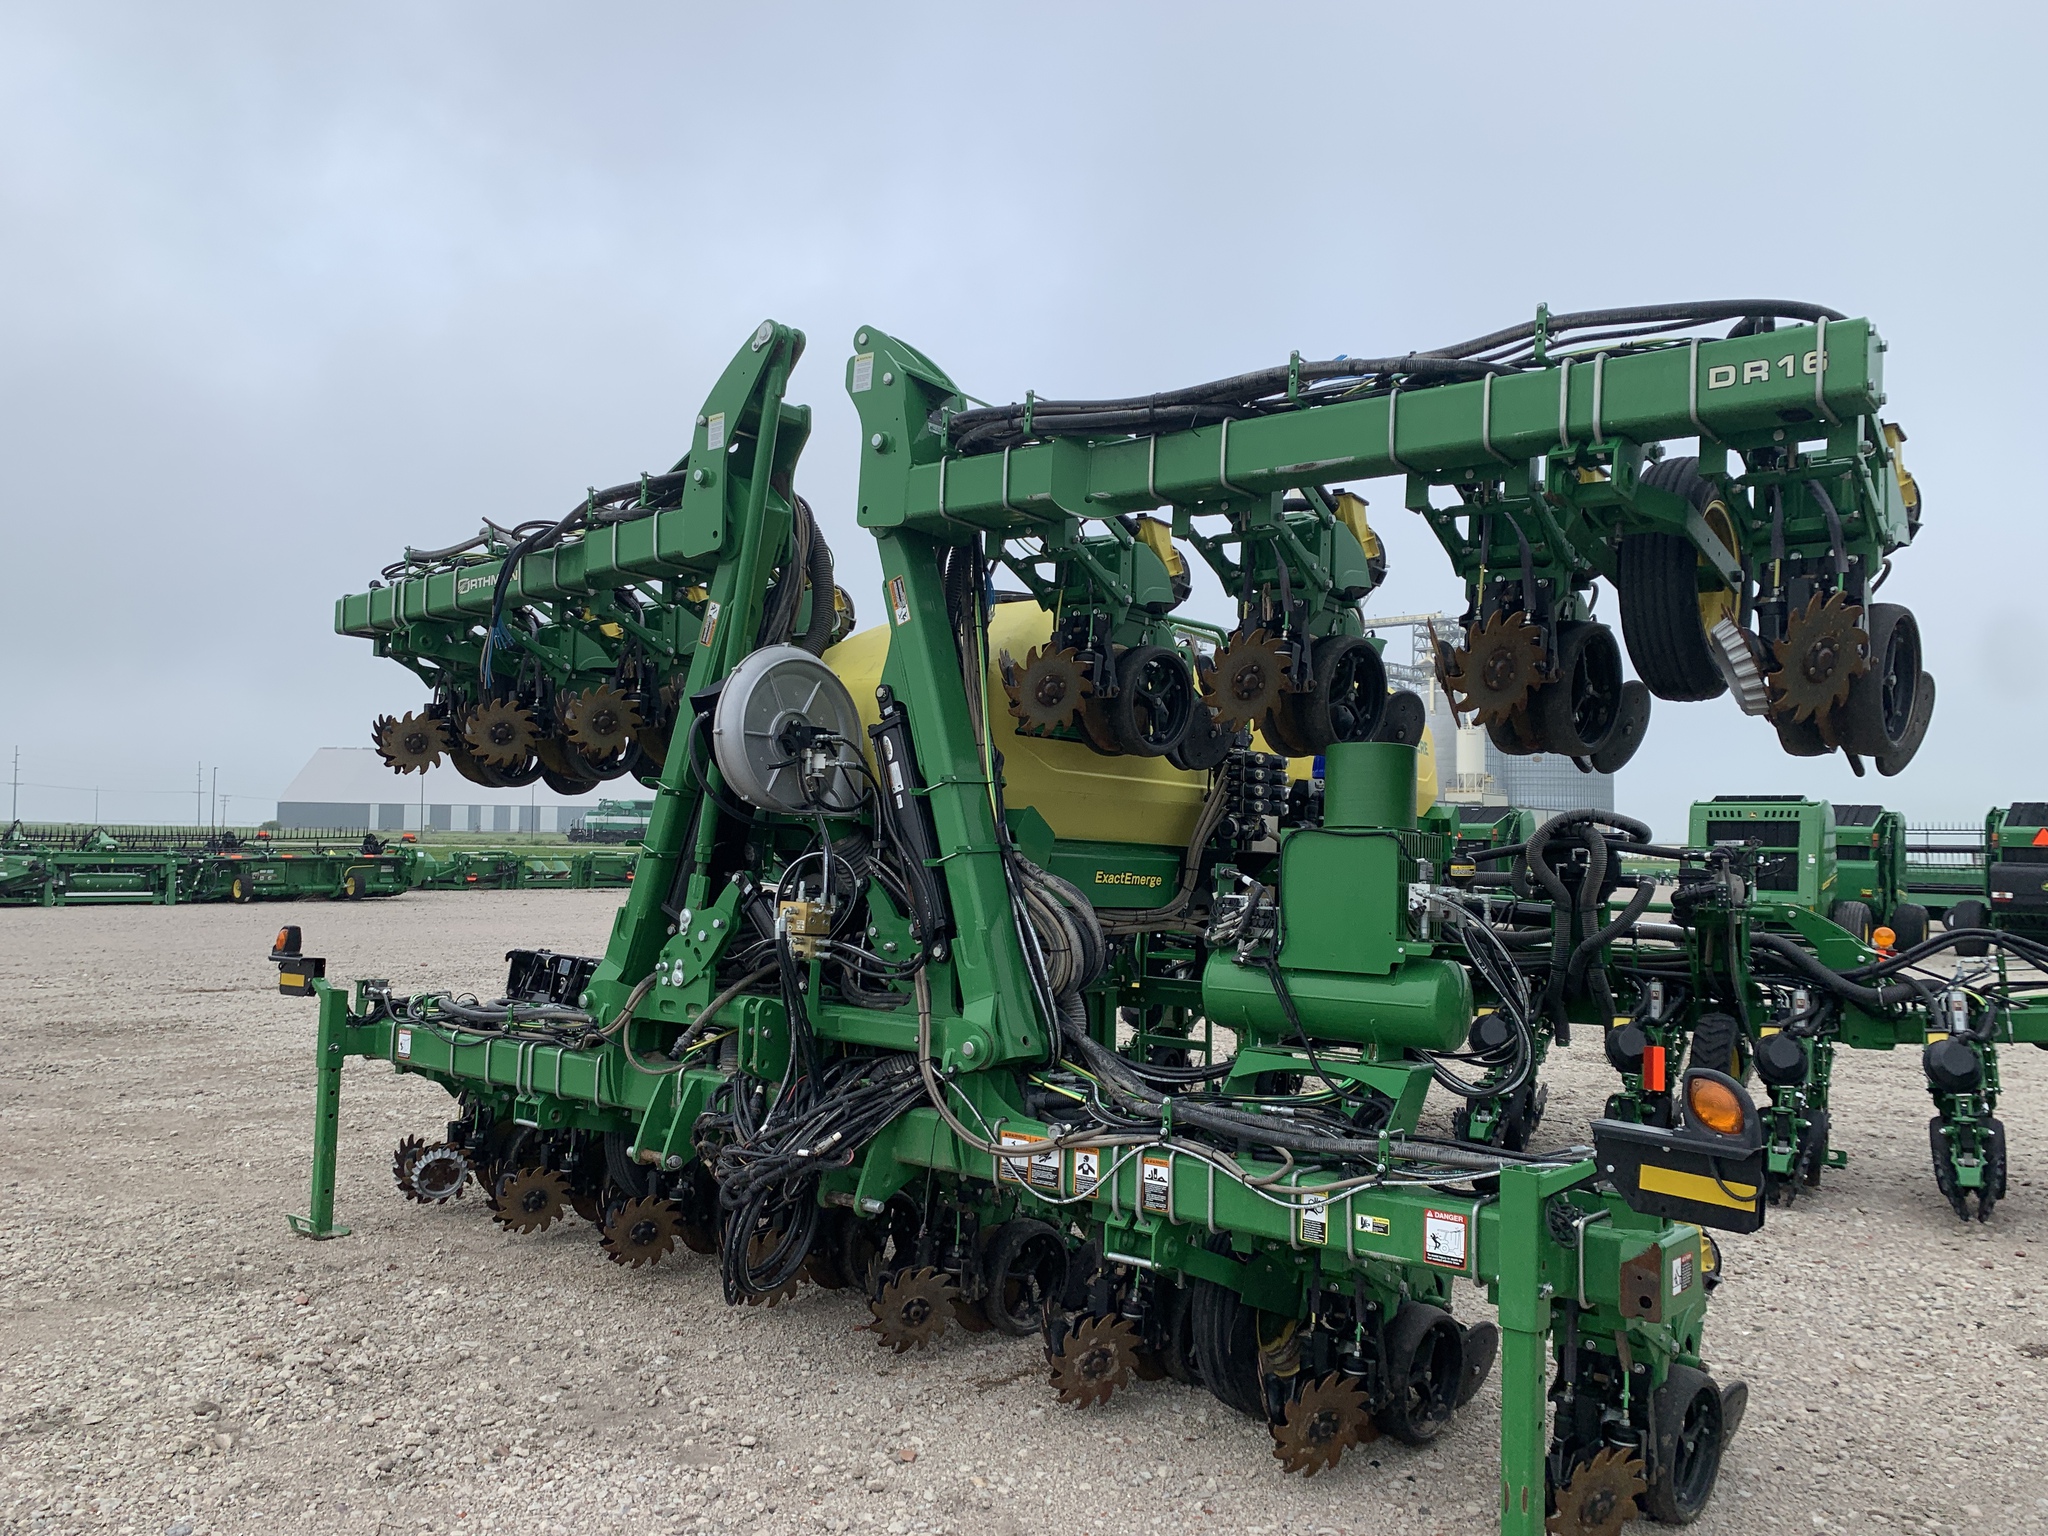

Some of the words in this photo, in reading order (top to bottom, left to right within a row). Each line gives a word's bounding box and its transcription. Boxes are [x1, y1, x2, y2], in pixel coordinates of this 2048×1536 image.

[1708, 350, 1828, 390] DR16
[1095, 871, 1162, 888] ExactEmerge
[1434, 1211, 1464, 1223] DANGER
